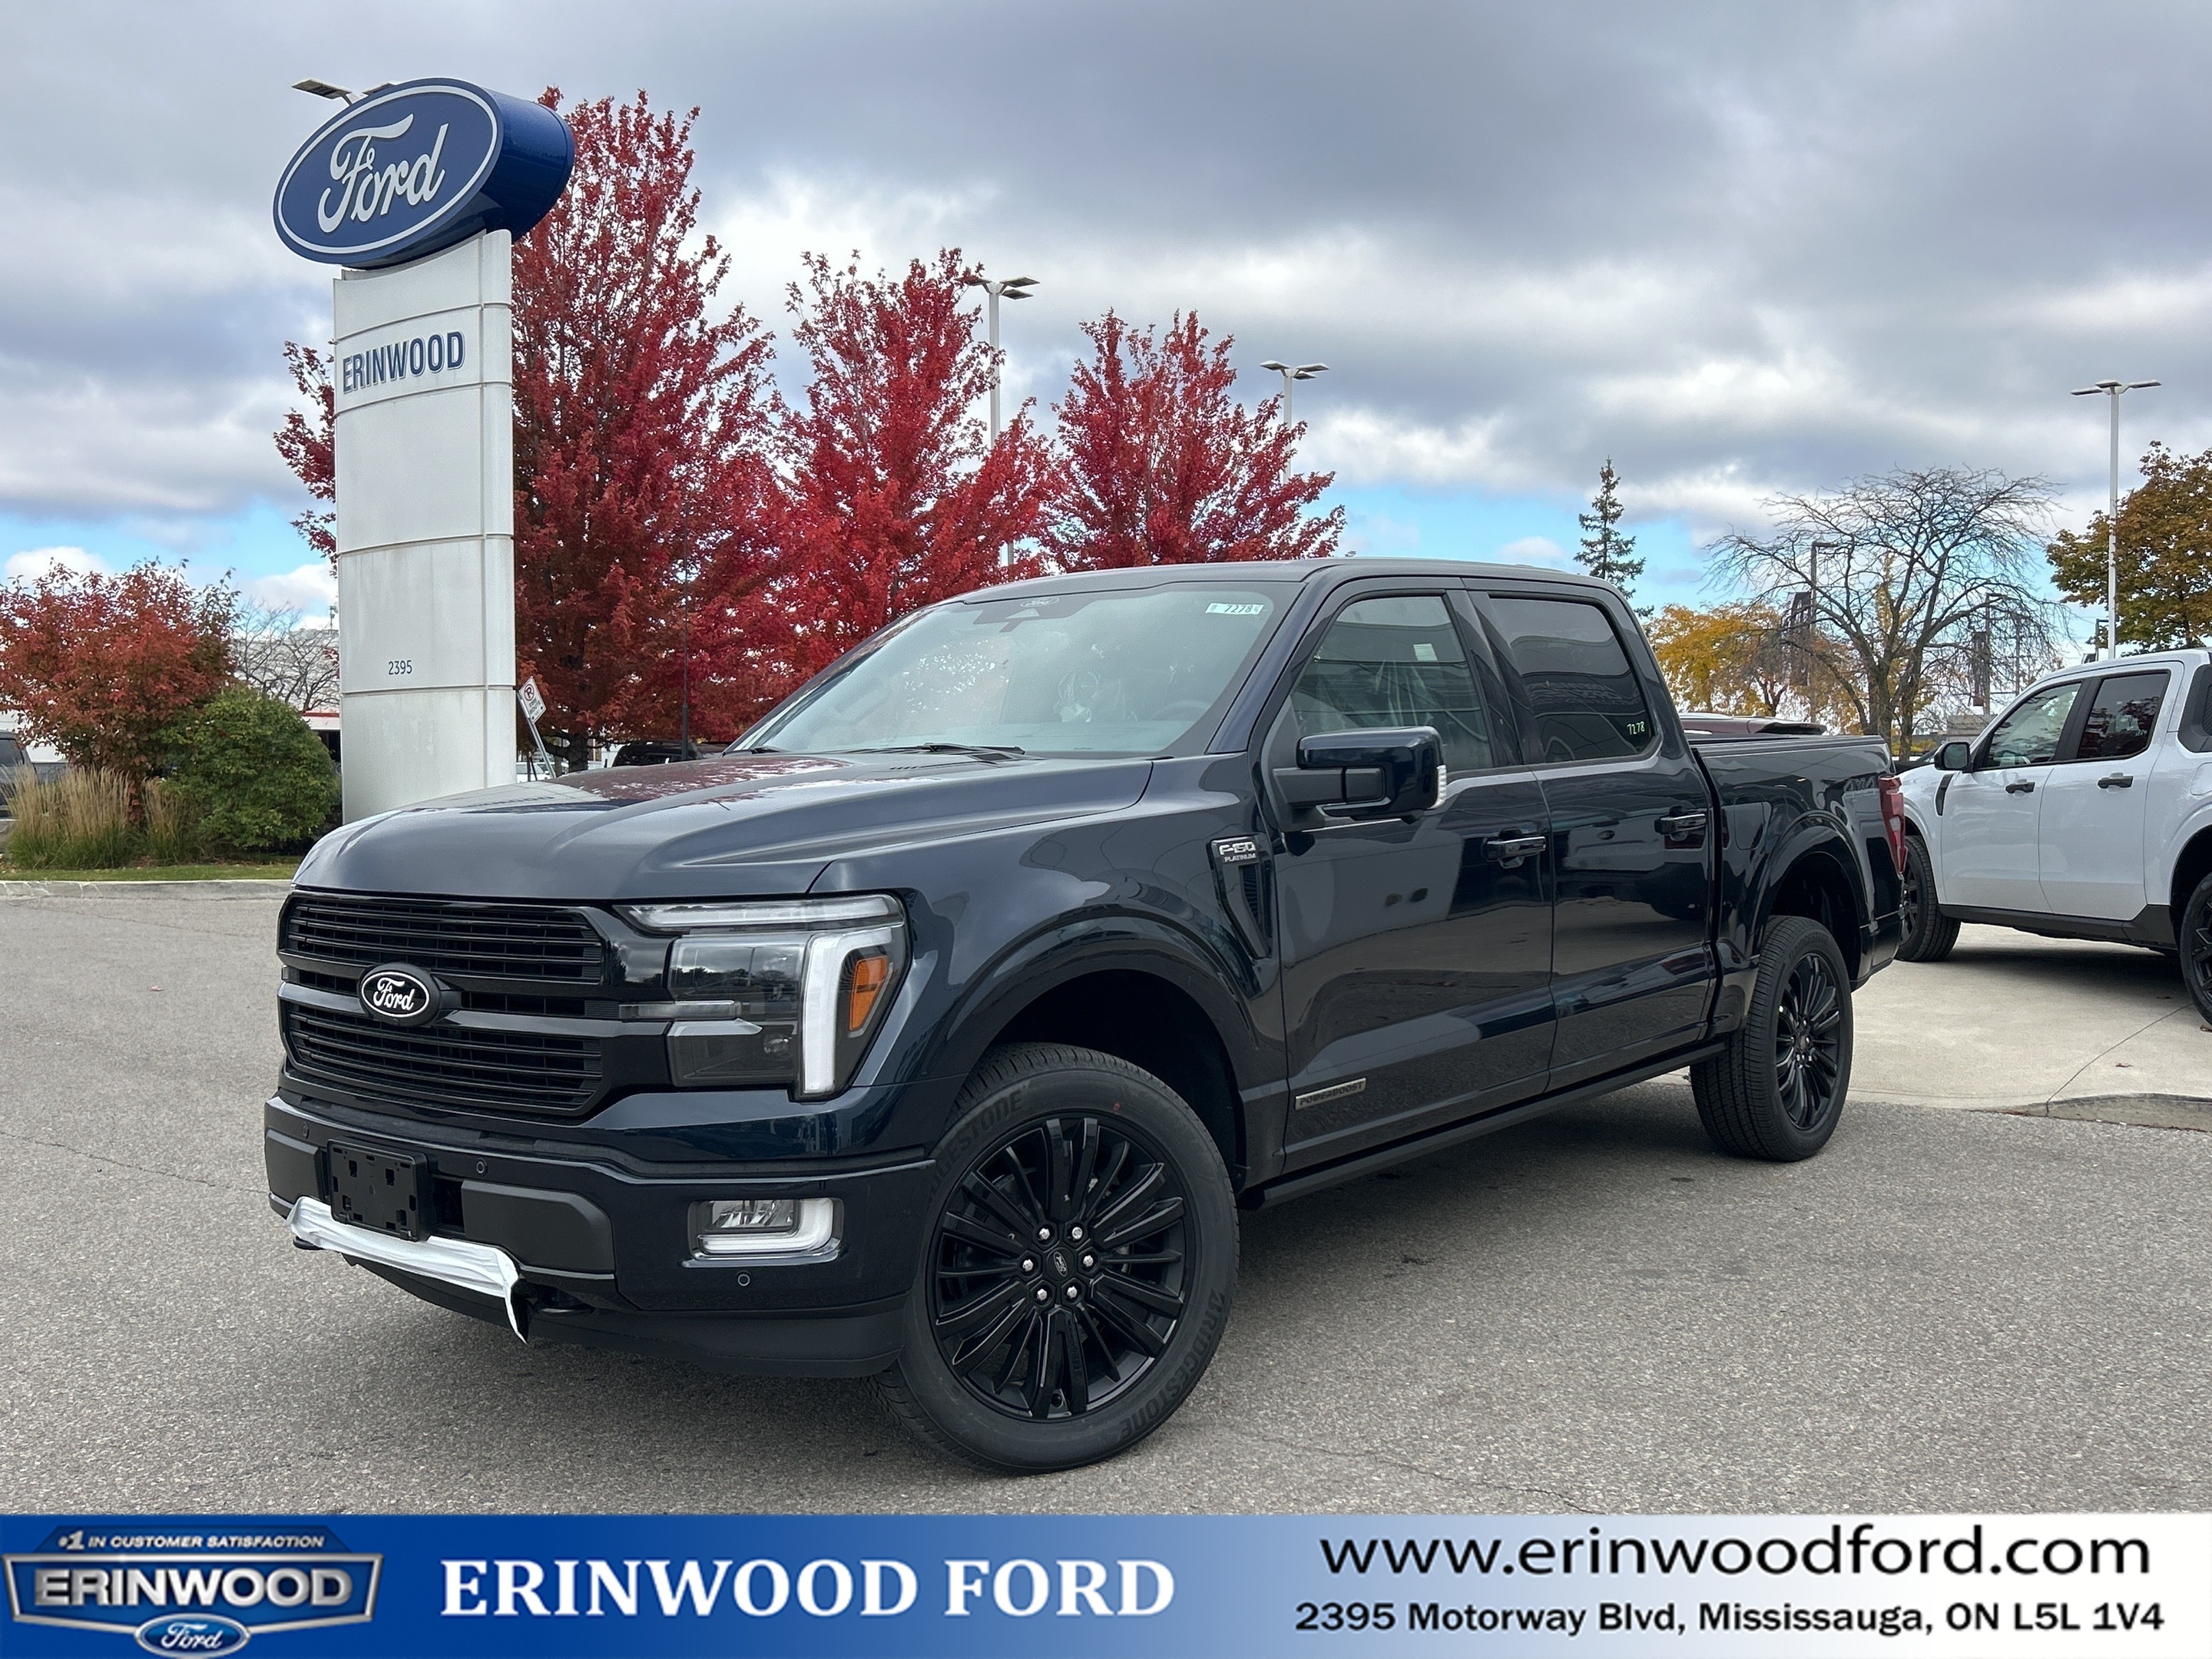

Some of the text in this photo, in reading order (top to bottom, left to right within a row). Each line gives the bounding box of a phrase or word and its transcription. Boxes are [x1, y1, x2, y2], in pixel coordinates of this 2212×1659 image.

[318, 114, 449, 233] Ford
[343, 330, 465, 395] ERINWOOD
[1224, 604, 1253, 613] 7278
[388, 660, 412, 675] 2395
[1219, 841, 1257, 856] F-150
[1224, 853, 1257, 863] PLATINUM
[373, 976, 416, 1011] Ford
[1120, 1289, 1226, 1440] BRIDGESTONE
